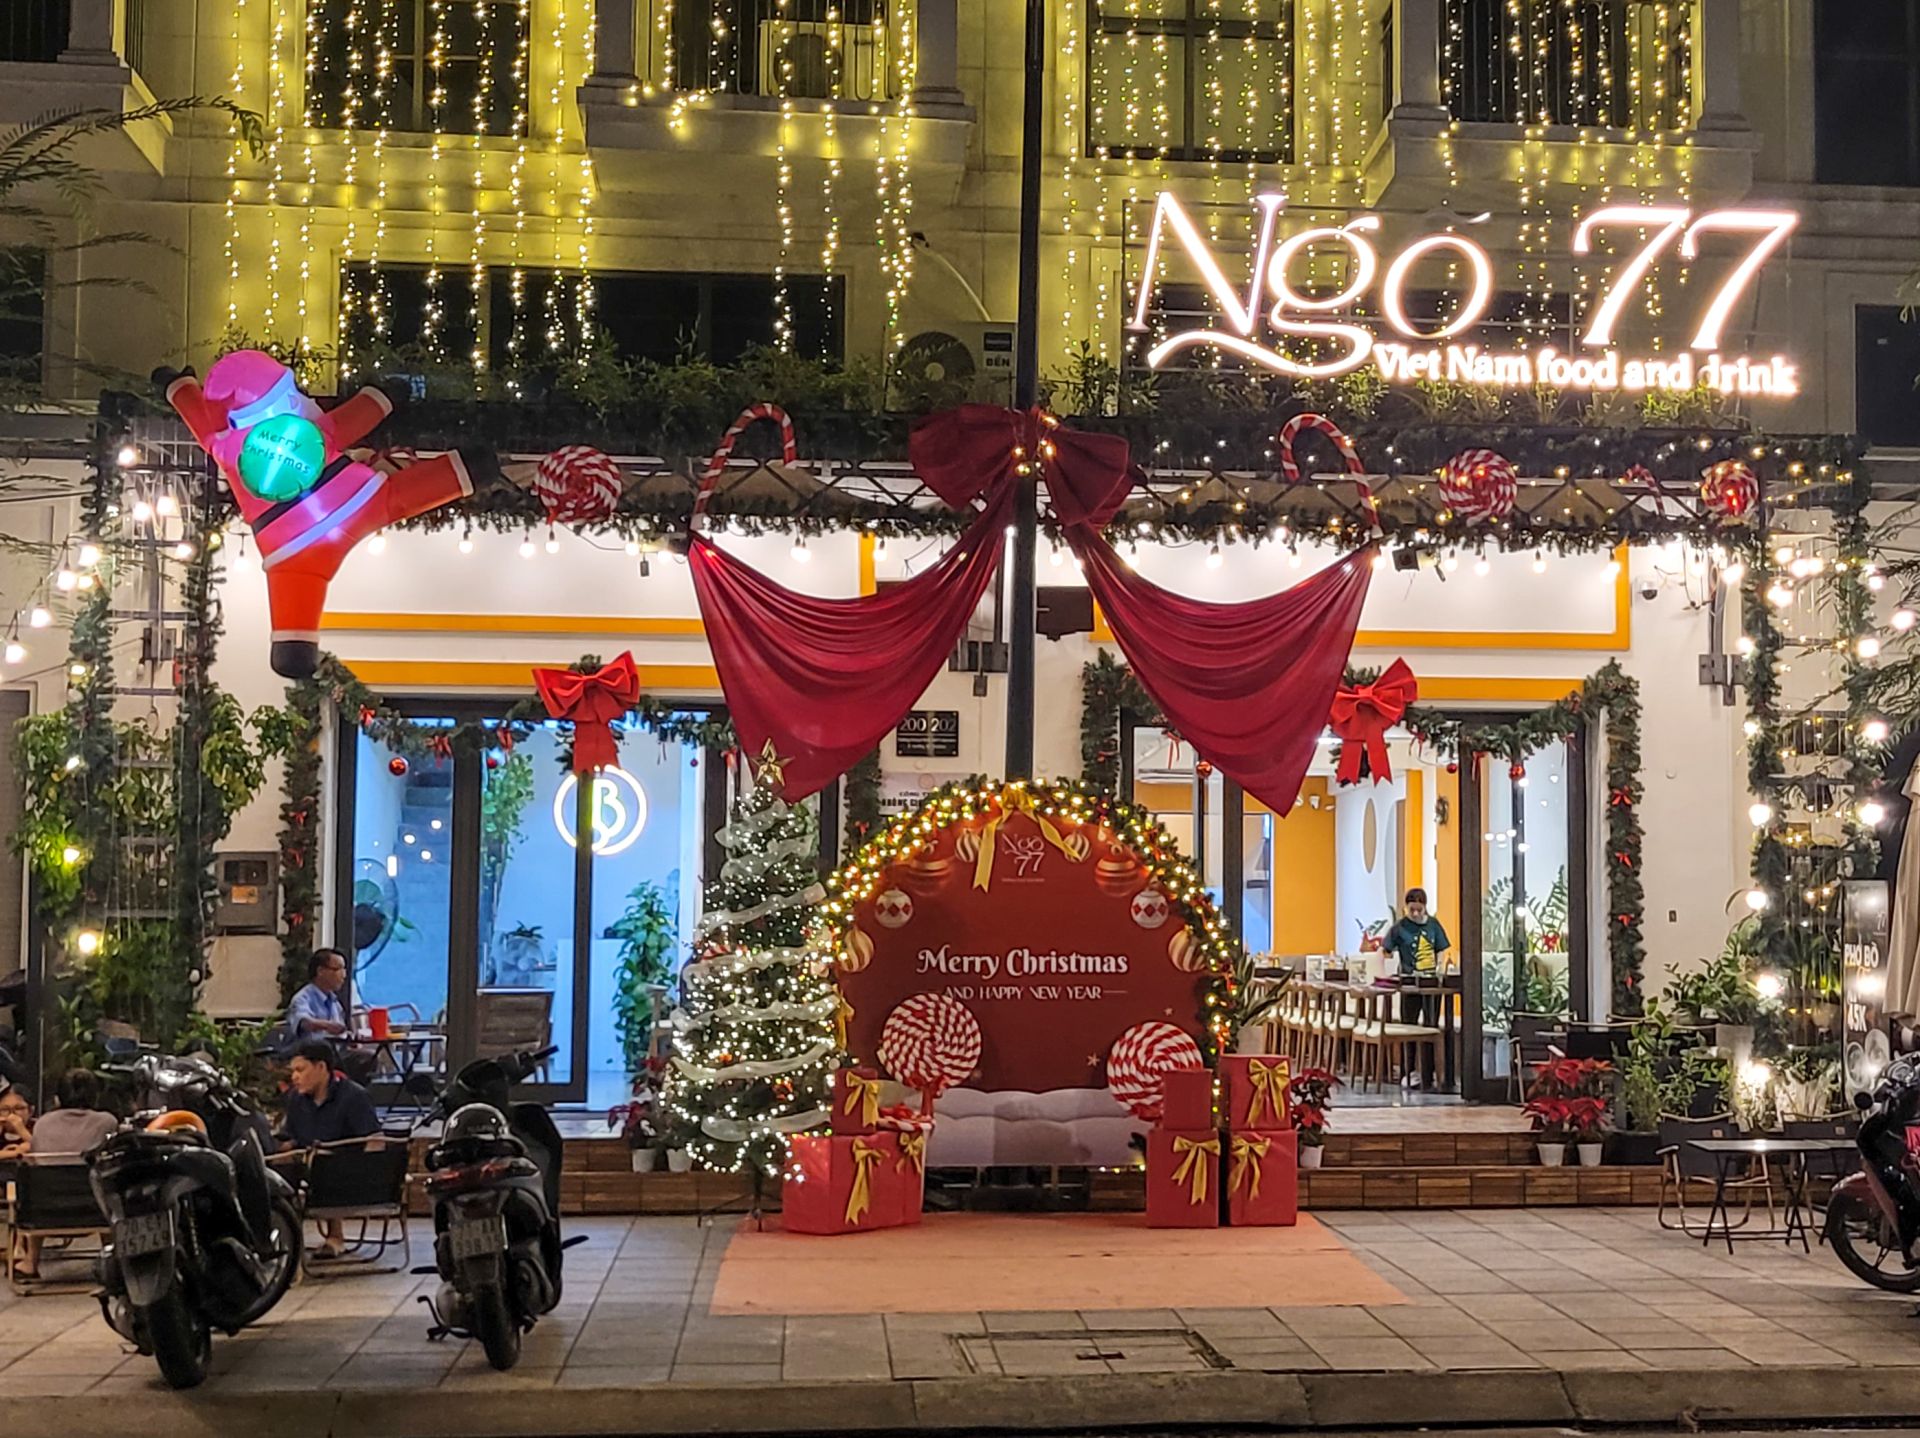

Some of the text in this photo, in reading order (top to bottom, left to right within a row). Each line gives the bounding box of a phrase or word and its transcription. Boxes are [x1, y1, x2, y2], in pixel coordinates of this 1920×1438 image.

[1571, 205, 1800, 351] 77
[1373, 342, 1800, 396] Viet Nam food and drink
[258, 430, 301, 451] Merry
[1014, 852, 1045, 877] 77
[916, 945, 1128, 979] Merry Christmas
[945, 986, 1101, 999] AND HAPPY NEW YEAR
